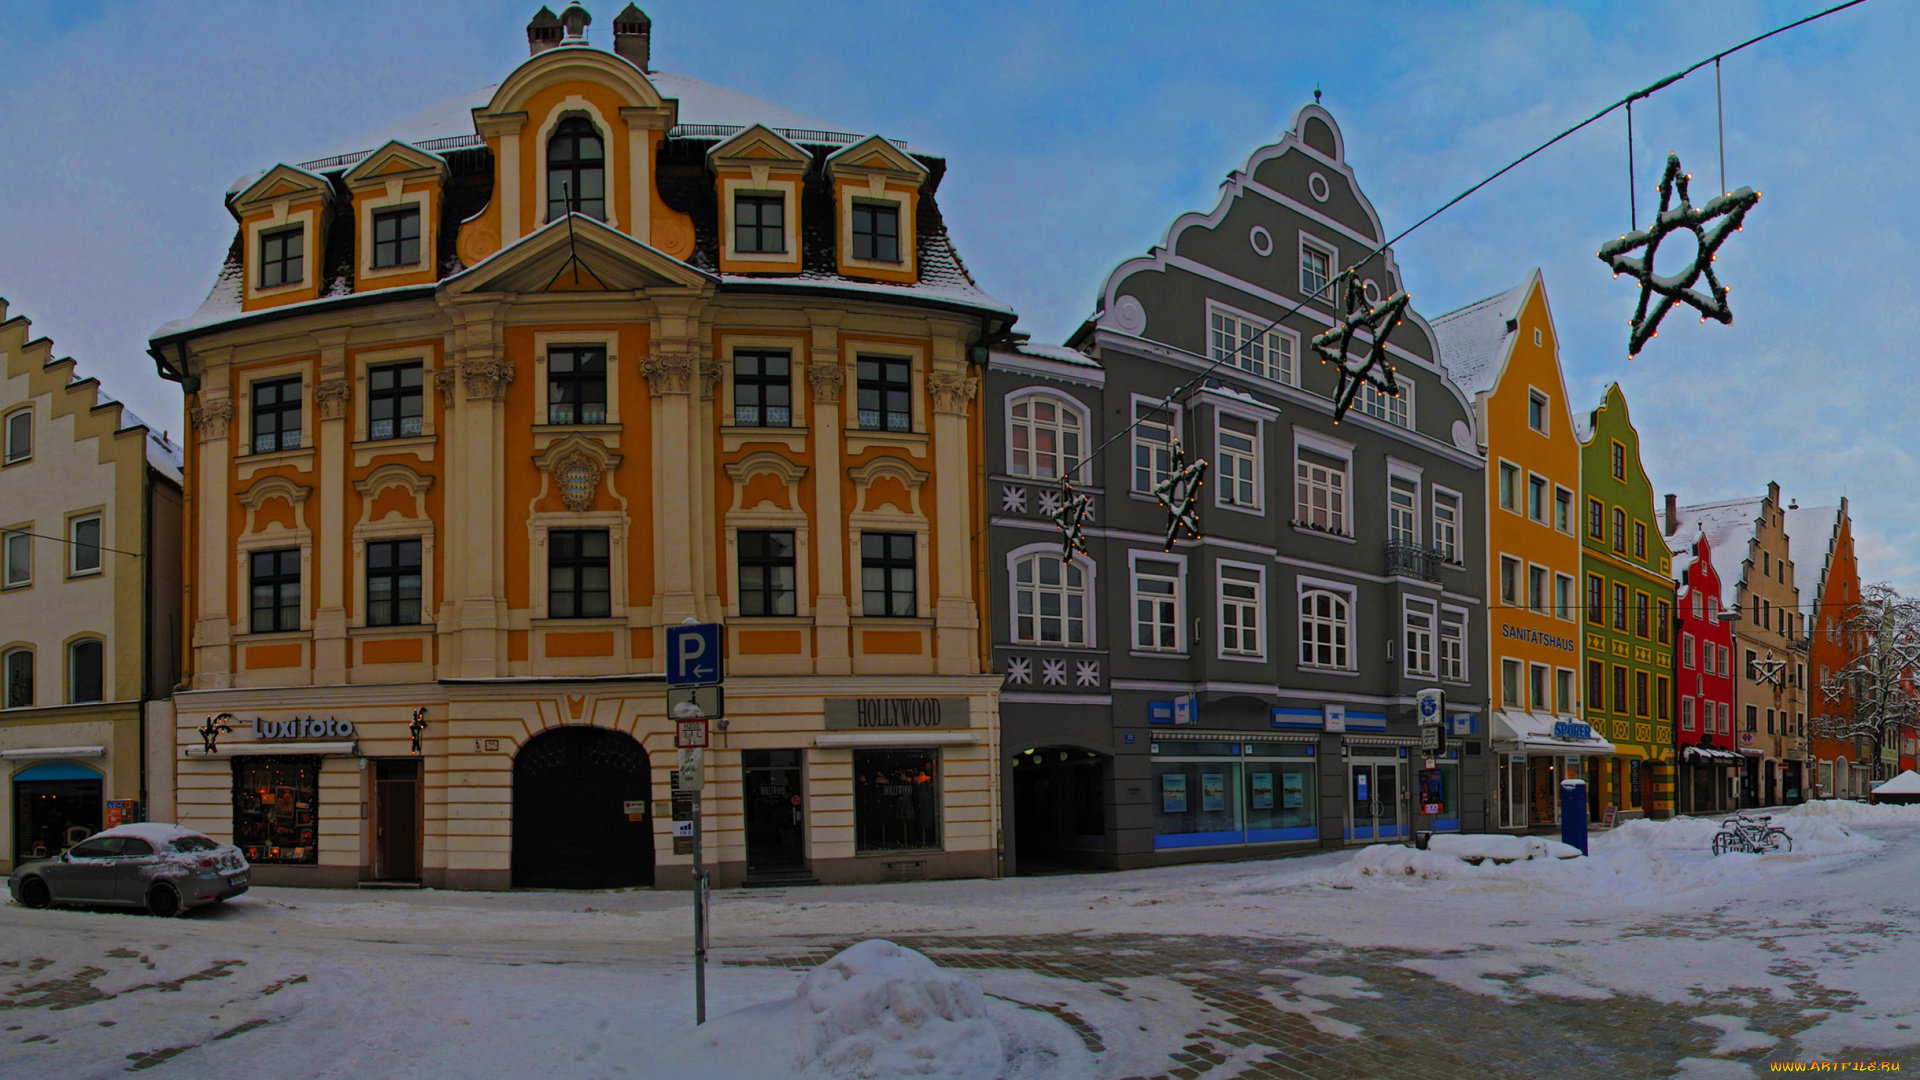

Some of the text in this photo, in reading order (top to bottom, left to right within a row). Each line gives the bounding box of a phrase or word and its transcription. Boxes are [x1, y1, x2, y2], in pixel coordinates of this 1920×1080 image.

[1502, 623, 1574, 652] SANITÄTSHAUS
[679, 633, 706, 676] P
[857, 697, 941, 728] HOLLYWOOD
